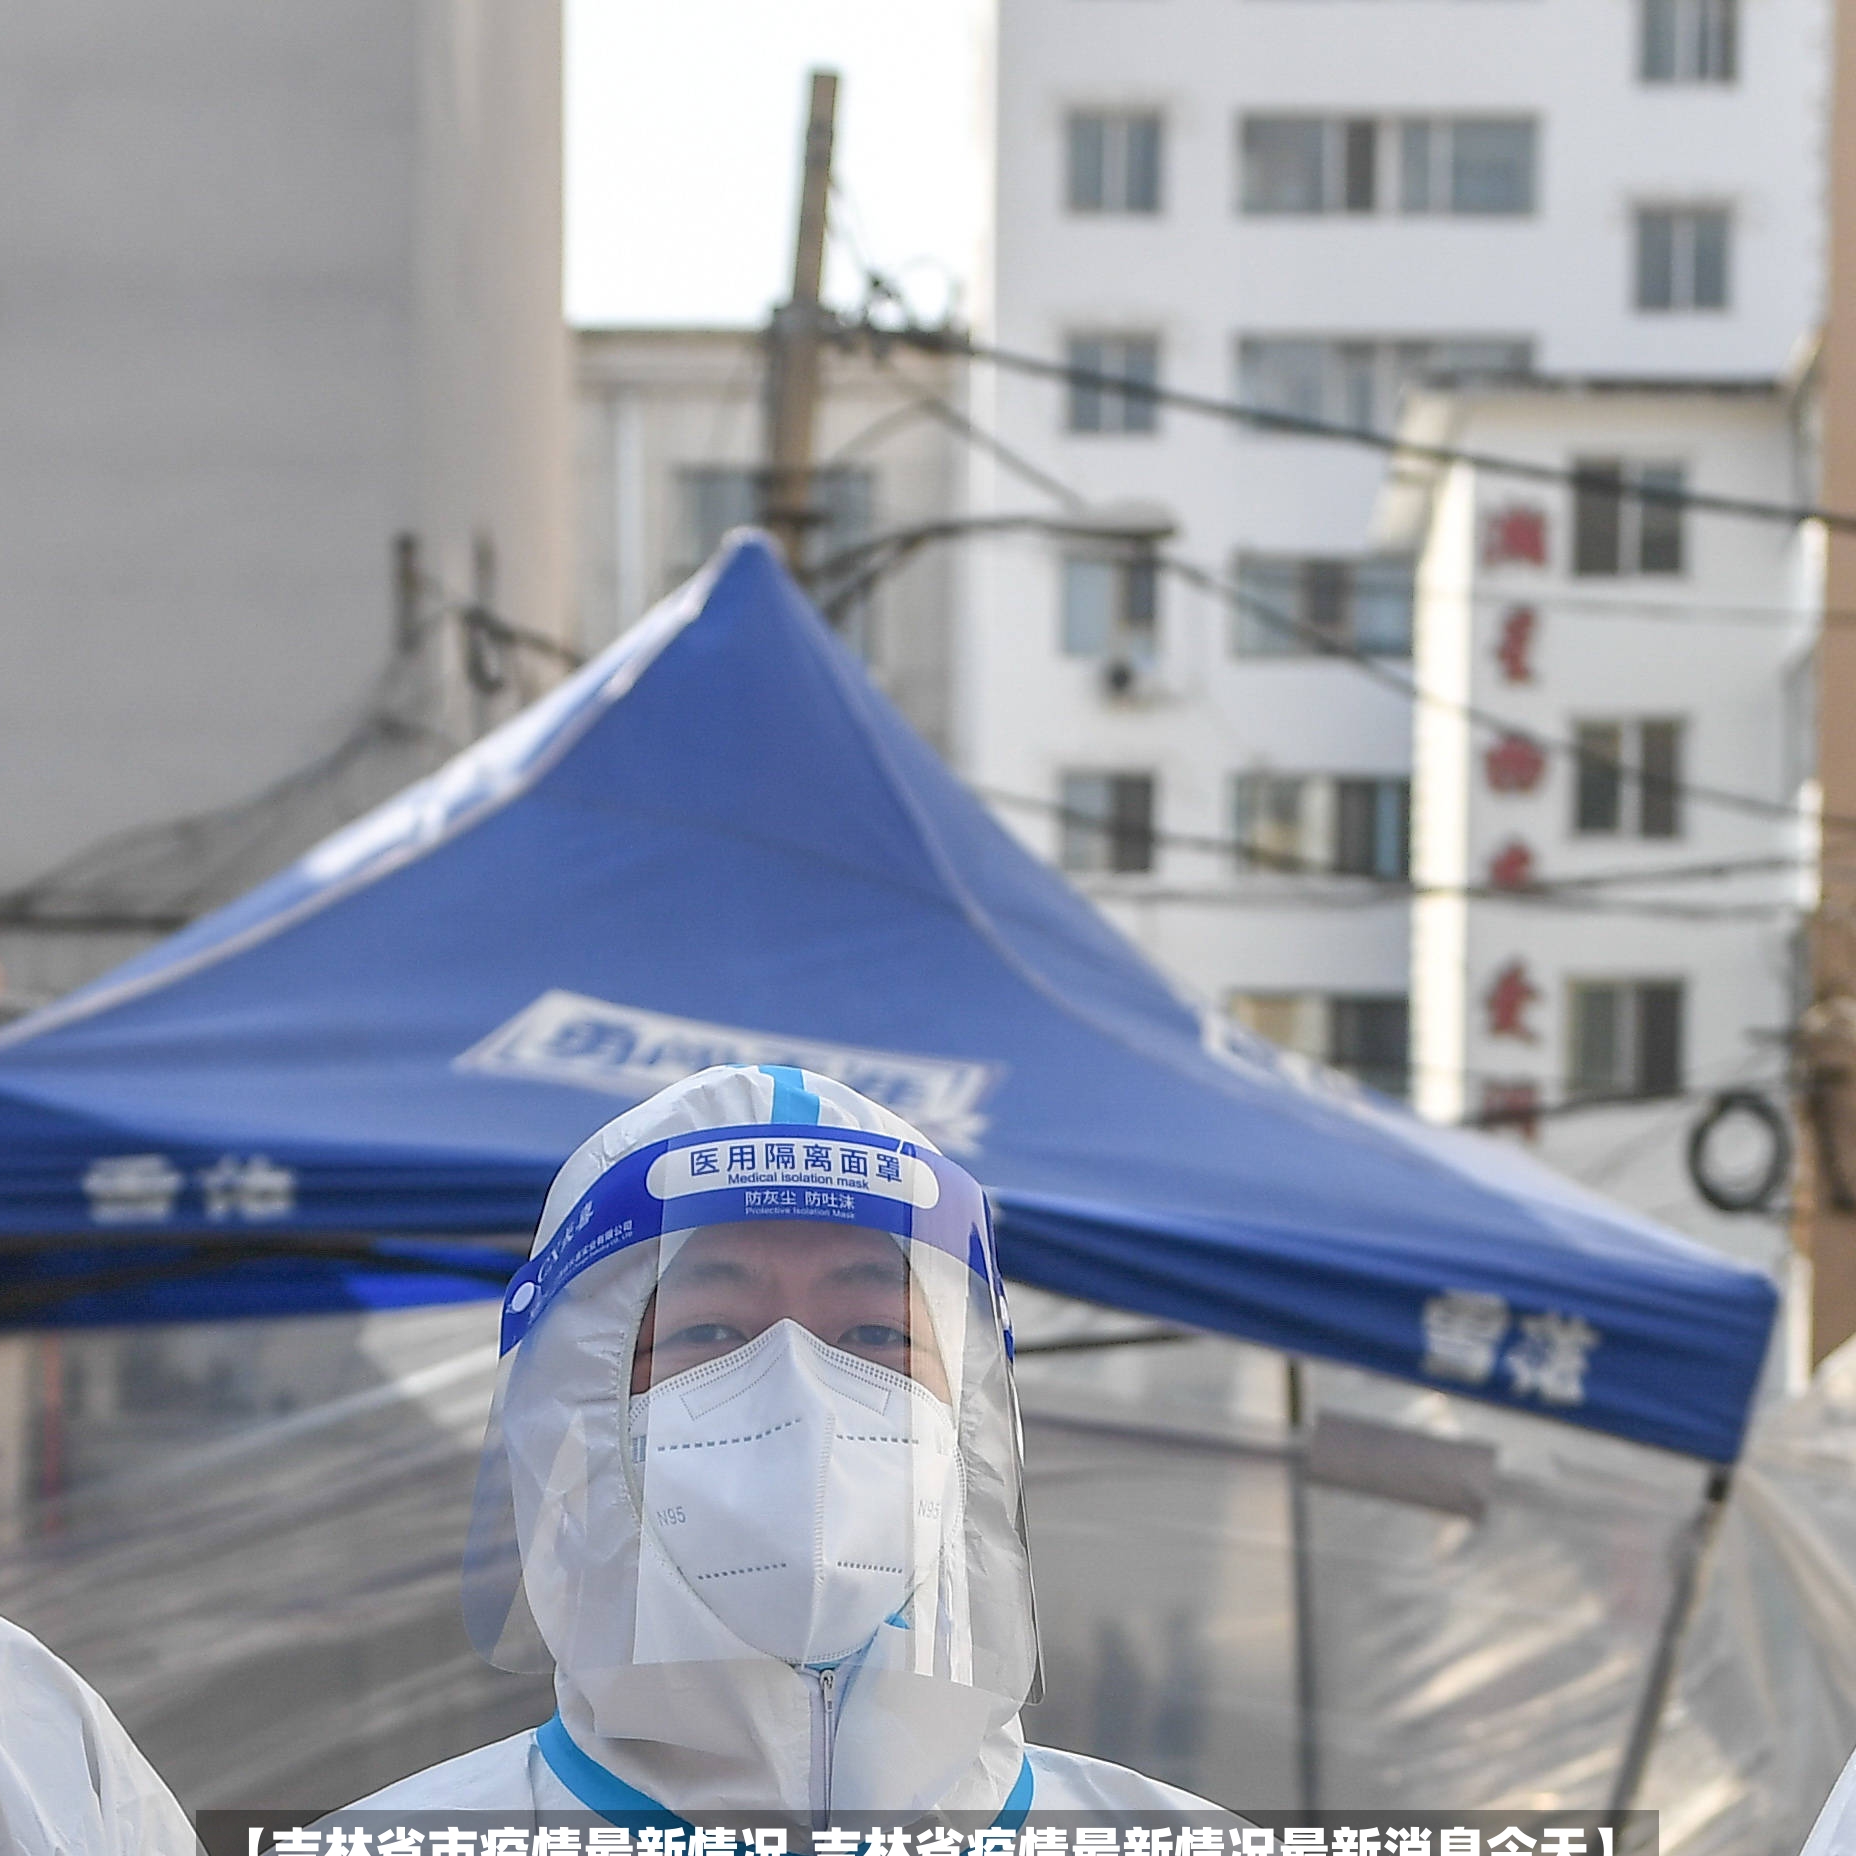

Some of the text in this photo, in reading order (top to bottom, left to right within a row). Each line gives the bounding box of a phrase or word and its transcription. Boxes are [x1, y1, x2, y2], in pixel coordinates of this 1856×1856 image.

[690, 1143, 903, 1183] 医用隔离面罩
[728, 1171, 777, 1185] Medical
[837, 1176, 870, 1190] mask
[745, 1190, 855, 1210] 防灰尘 防吐沫
[656, 1506, 686, 1526] N95
[918, 1499, 943, 1519] N95
